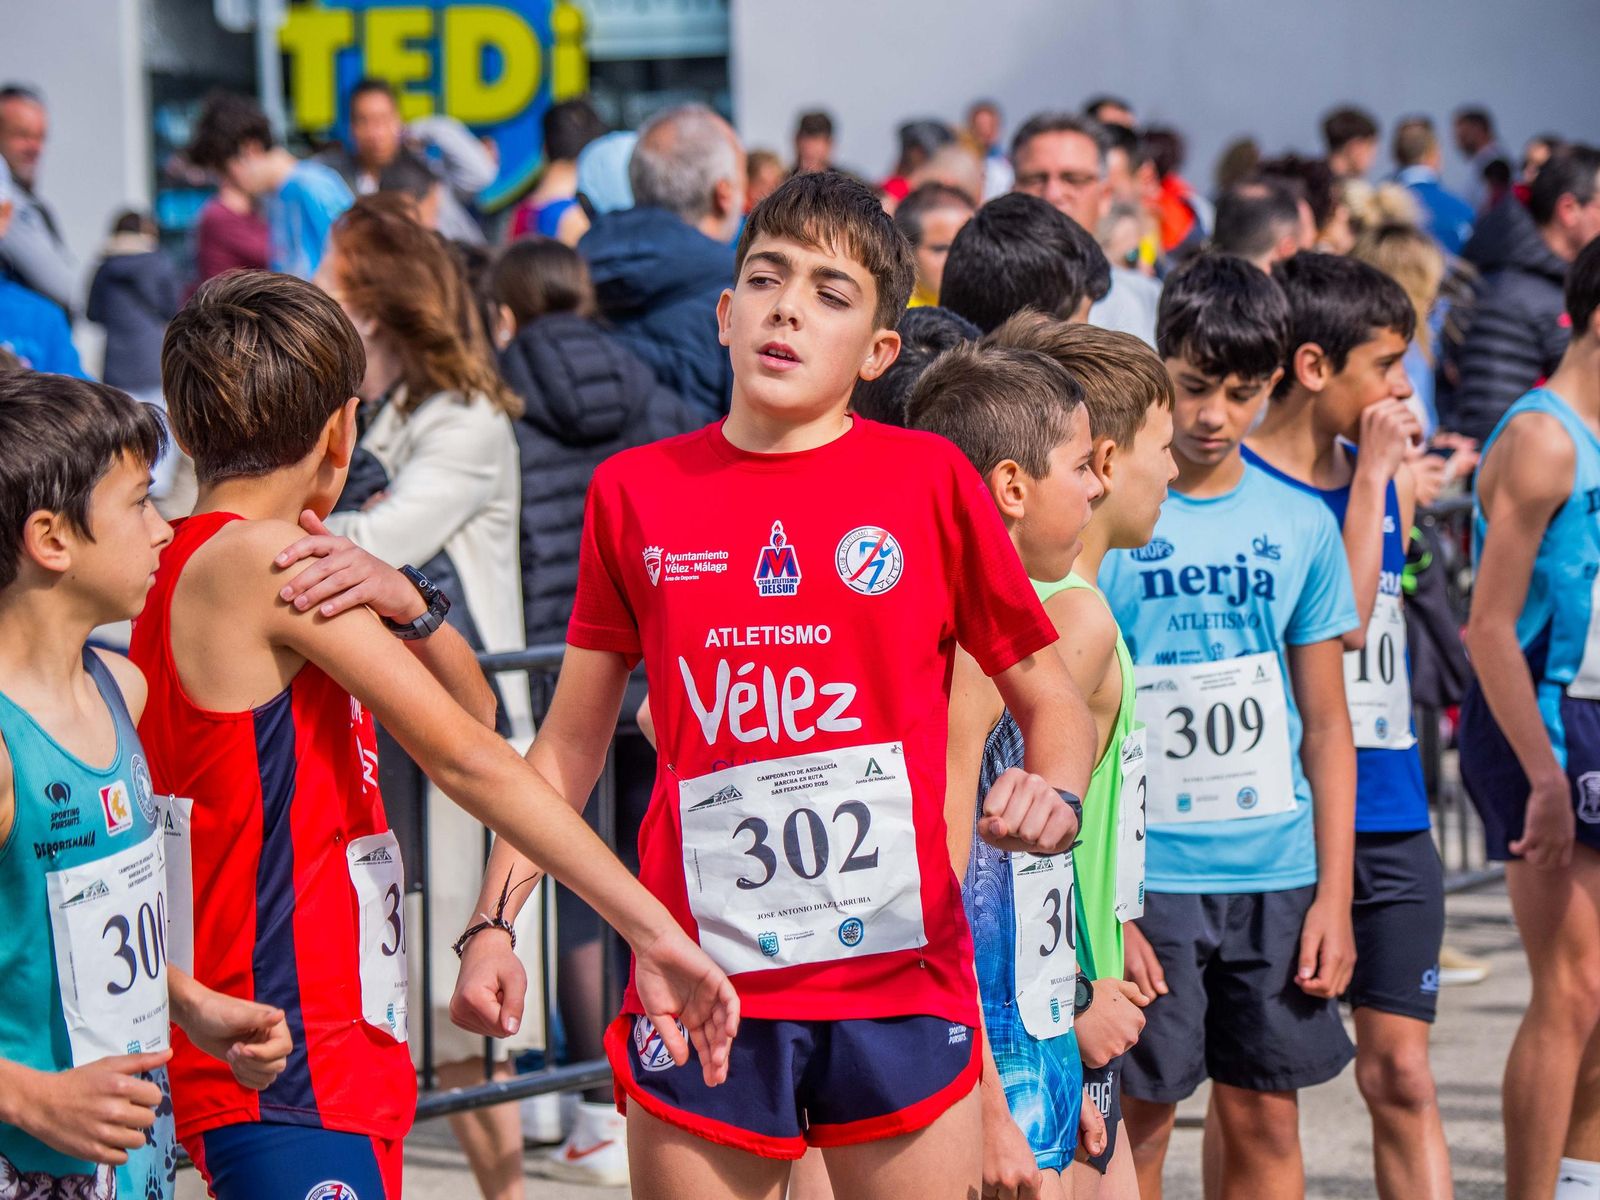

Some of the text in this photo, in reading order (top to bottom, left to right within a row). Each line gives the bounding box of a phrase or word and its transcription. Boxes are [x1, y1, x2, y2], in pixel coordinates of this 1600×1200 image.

[665, 550, 729, 564] Ayuntamiento
[761, 584, 795, 594] DELSUR
[772, 577, 798, 585] ATLETISMO
[1139, 554, 1276, 607] nerja
[1166, 612, 1261, 633] ATLETISMO
[705, 624, 832, 648] ATLETISMO
[678, 655, 862, 746] Vélez
[1164, 697, 1265, 760] 309
[757, 770, 796, 782] CAMPEONATO
[805, 762, 838, 774] ANDALUCÍA
[774, 778, 799, 787] MARCHA
[807, 774, 824, 782] RUTA
[783, 783, 813, 793] FERNANDO
[814, 780, 829, 788] 2025
[51, 807, 80, 822] SPORTING
[733, 800, 879, 890] 302
[757, 896, 872, 920] JOSE ANTONIO DIAZ LARRUBIA
